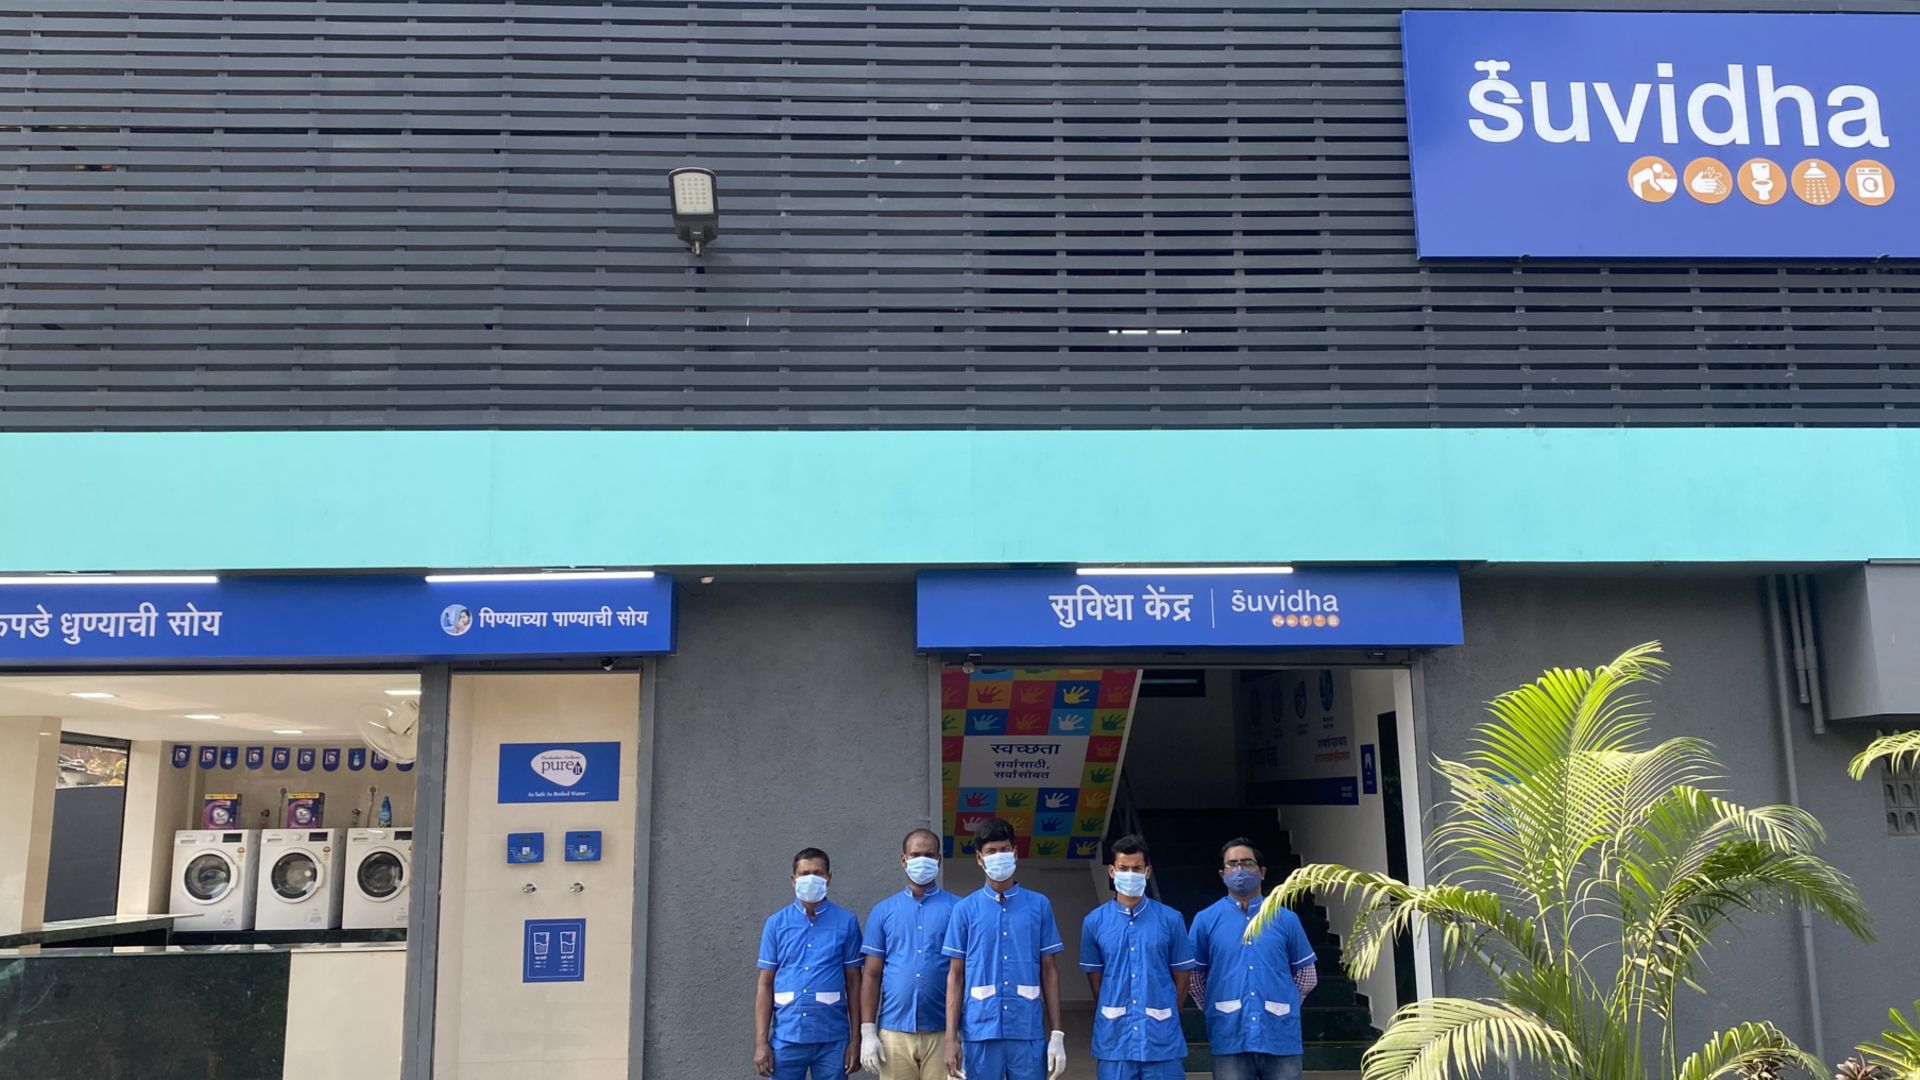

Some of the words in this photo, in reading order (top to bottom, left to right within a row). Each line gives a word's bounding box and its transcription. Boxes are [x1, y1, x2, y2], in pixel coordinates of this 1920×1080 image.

[1468, 59, 1890, 148] suvidha
[479, 607, 548, 628] पिण्याच्या
[552, 605, 613, 627] पाण्याची
[616, 606, 649, 627] सोय
[1049, 585, 1134, 628] सुविधा
[1142, 585, 1193, 621] केंद्र
[1231, 590, 1339, 612] suvidha
[60, 602, 158, 645] धुण्याची
[167, 602, 222, 636] सोय
[990, 743, 1062, 755] स्वच्छता
